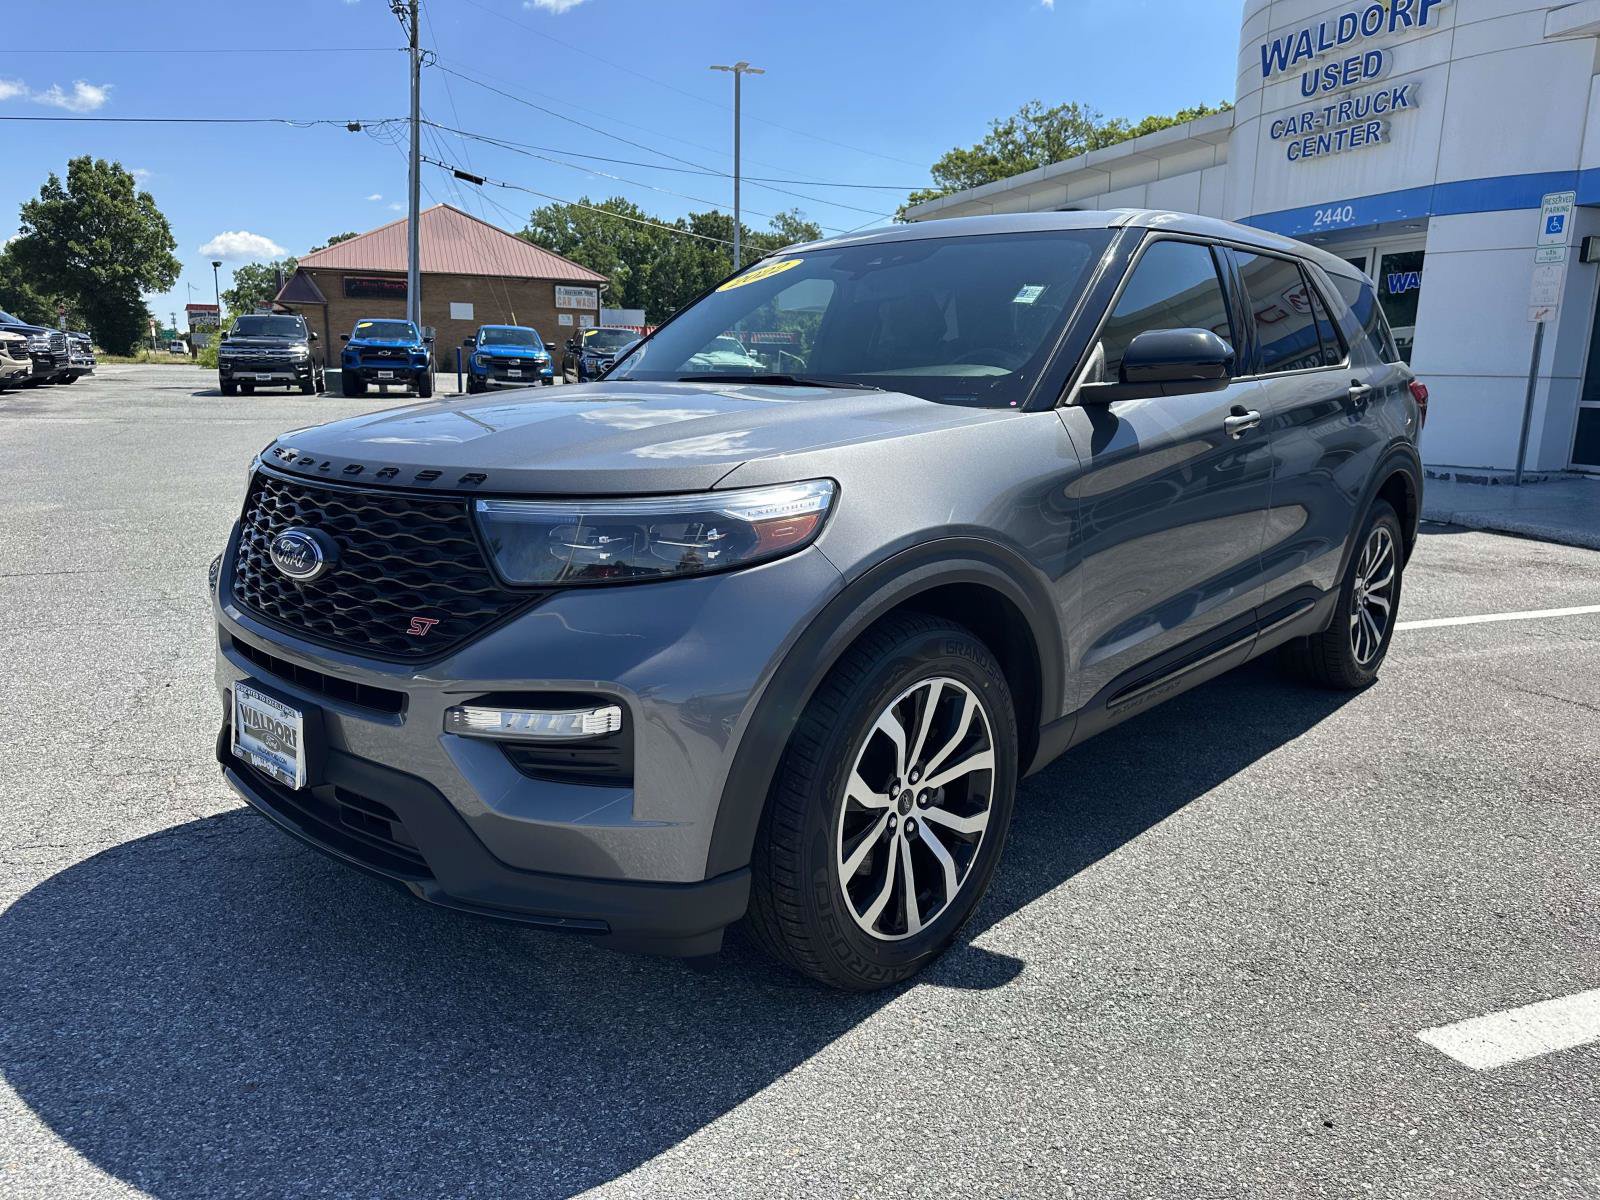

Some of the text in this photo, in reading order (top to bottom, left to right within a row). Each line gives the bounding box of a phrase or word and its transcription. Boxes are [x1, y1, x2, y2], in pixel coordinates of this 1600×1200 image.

[1260, 0, 1442, 78] WALDORF
[1300, 50, 1383, 97] USED
[1270, 85, 1410, 140] CAR-TRUCK
[1287, 121, 1382, 161] CENTER
[1544, 195, 1573, 205] RESERVED
[1545, 206, 1570, 214] PARKING
[1313, 206, 1352, 226] 2440
[557, 296, 596, 308] CAR WASH
[273, 447, 488, 485] EXPLORER
[277, 539, 307, 568] Ford
[406, 617, 440, 637] ST
[260, 694, 266, 702] TO
